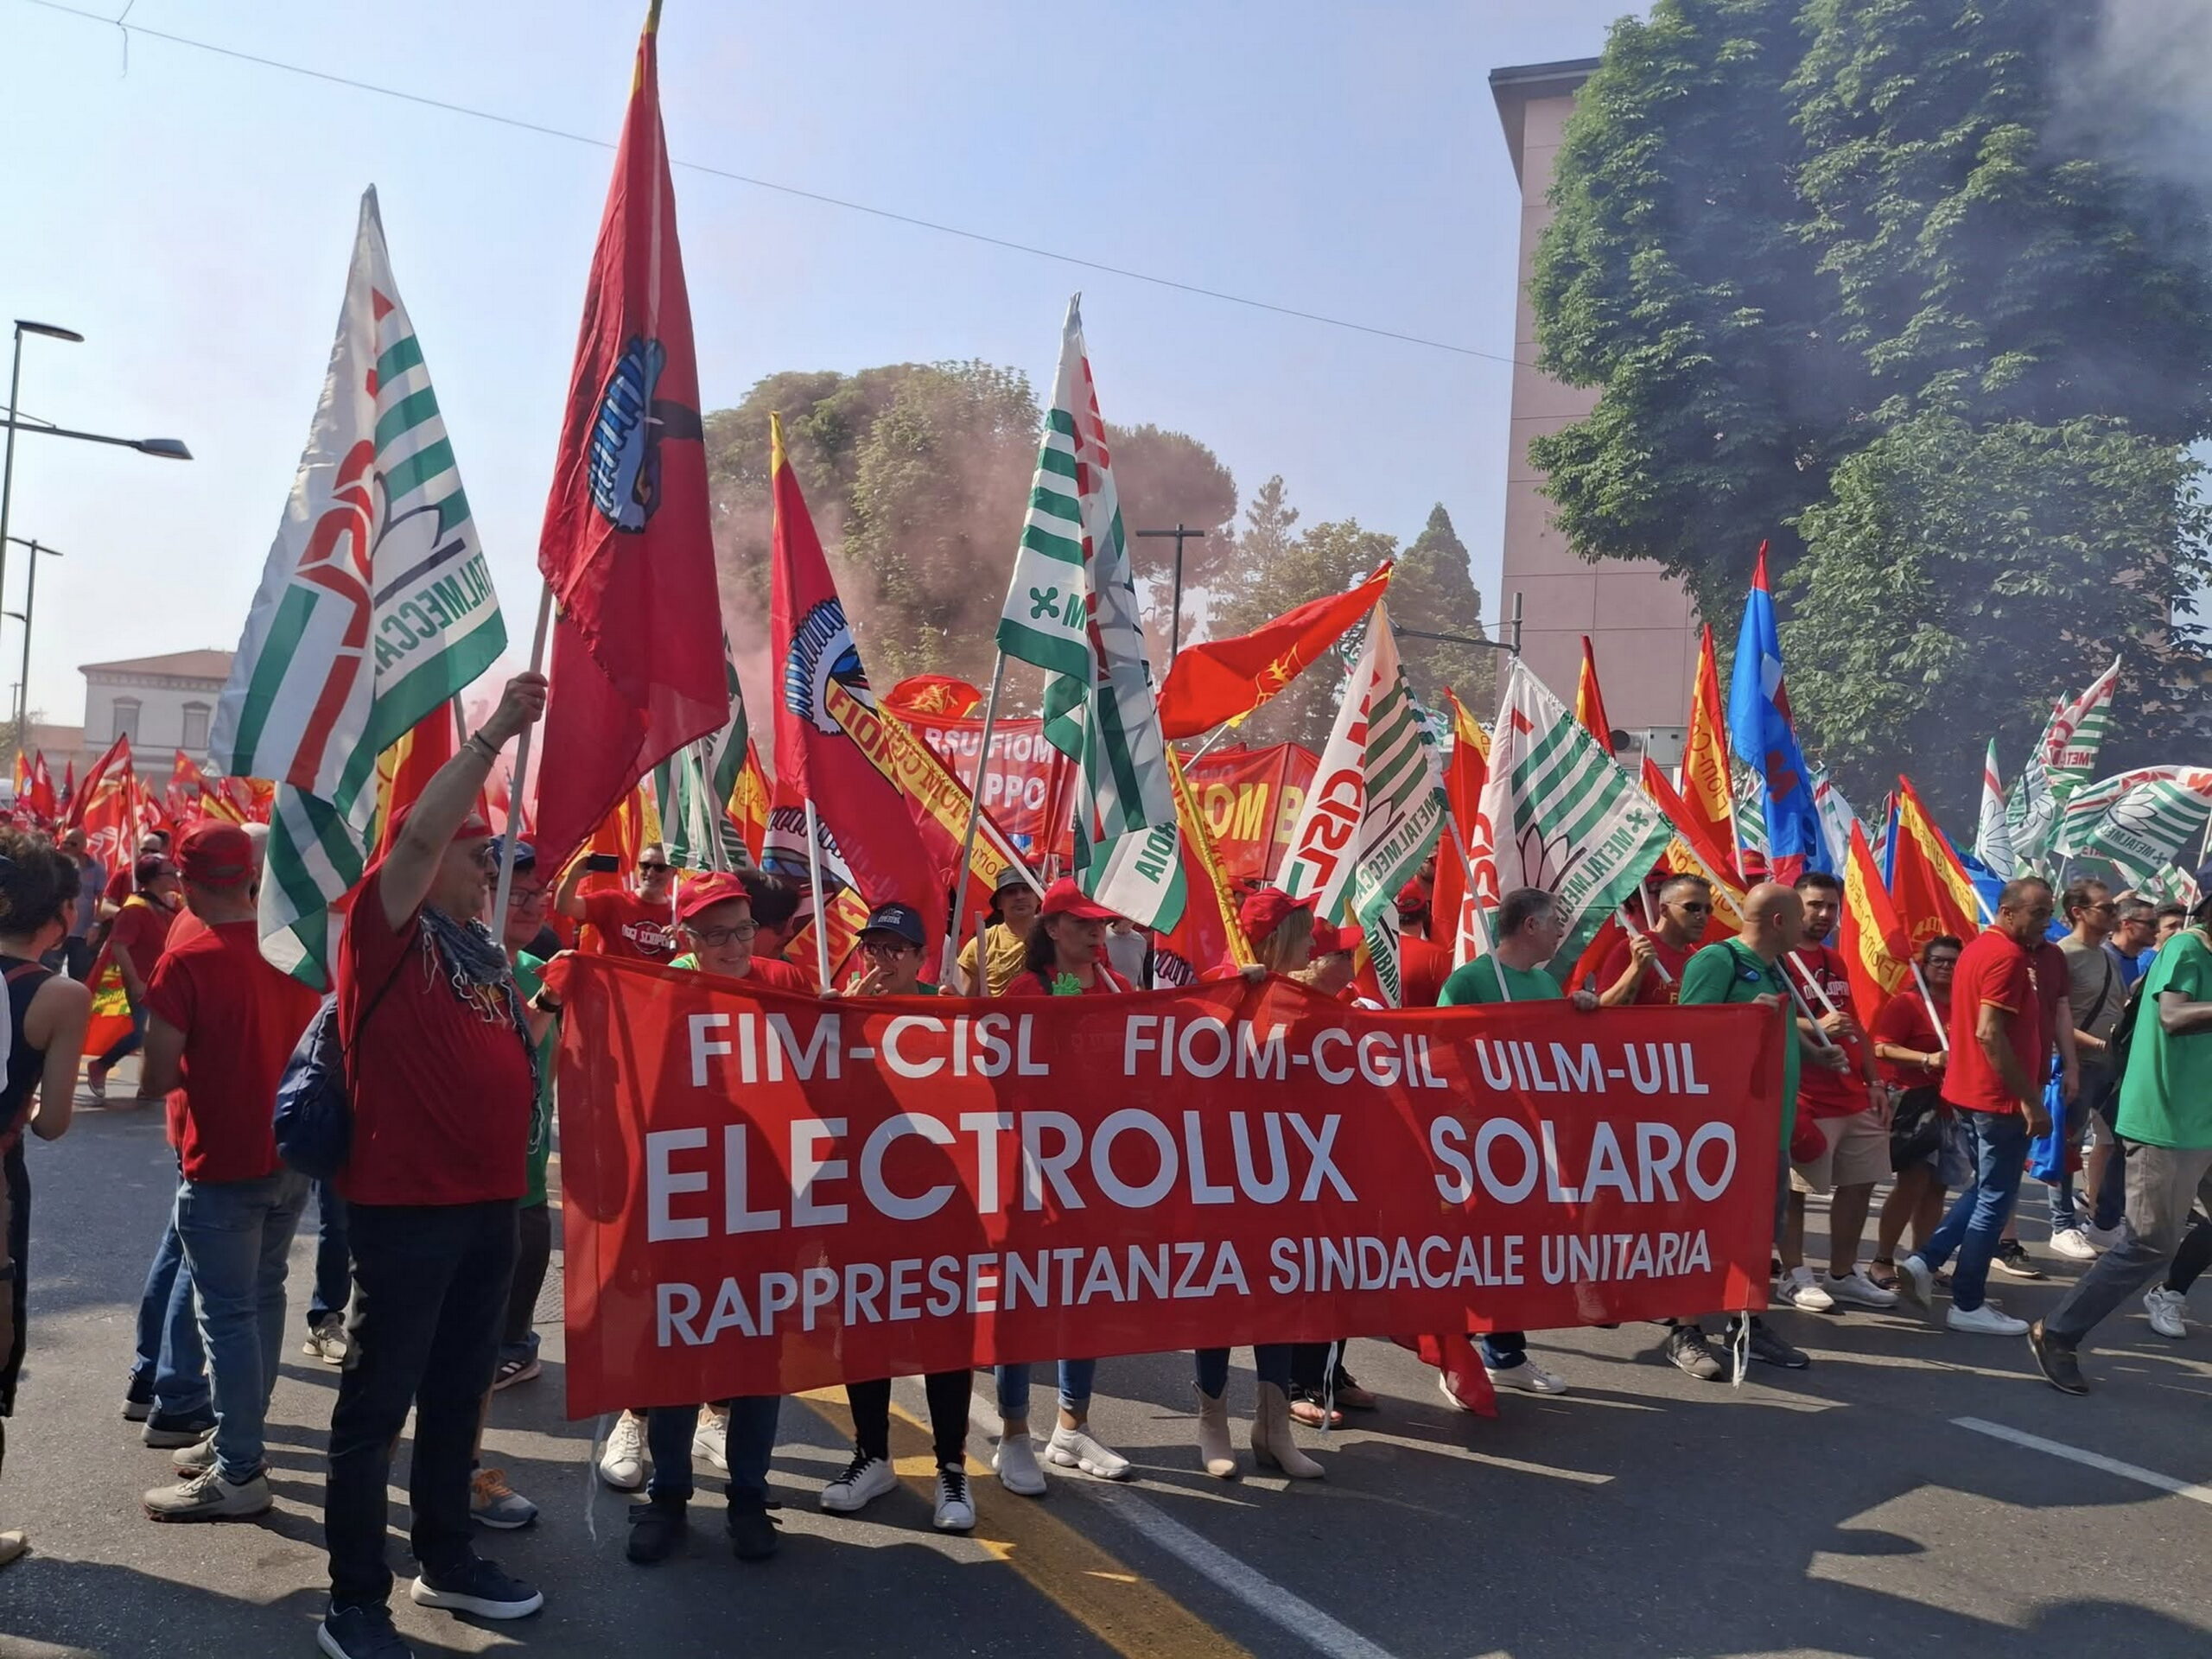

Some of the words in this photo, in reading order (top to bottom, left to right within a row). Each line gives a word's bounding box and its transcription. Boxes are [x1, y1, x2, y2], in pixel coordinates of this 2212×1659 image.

[924, 728, 980, 758] RSU
[689, 1013, 1049, 1086] FIM-CISL
[1124, 1014, 1447, 1088] FIOM-CGIL
[1475, 1038, 1709, 1094] UILM-UIL
[646, 1108, 1357, 1243] ELECTROLUX
[1430, 1116, 1736, 1204] SOLARO
[657, 1241, 1249, 1347] RAPPRESENTANZA
[1270, 1234, 1523, 1294] SINDACALE
[1541, 1229, 1712, 1283] UNITARIA
